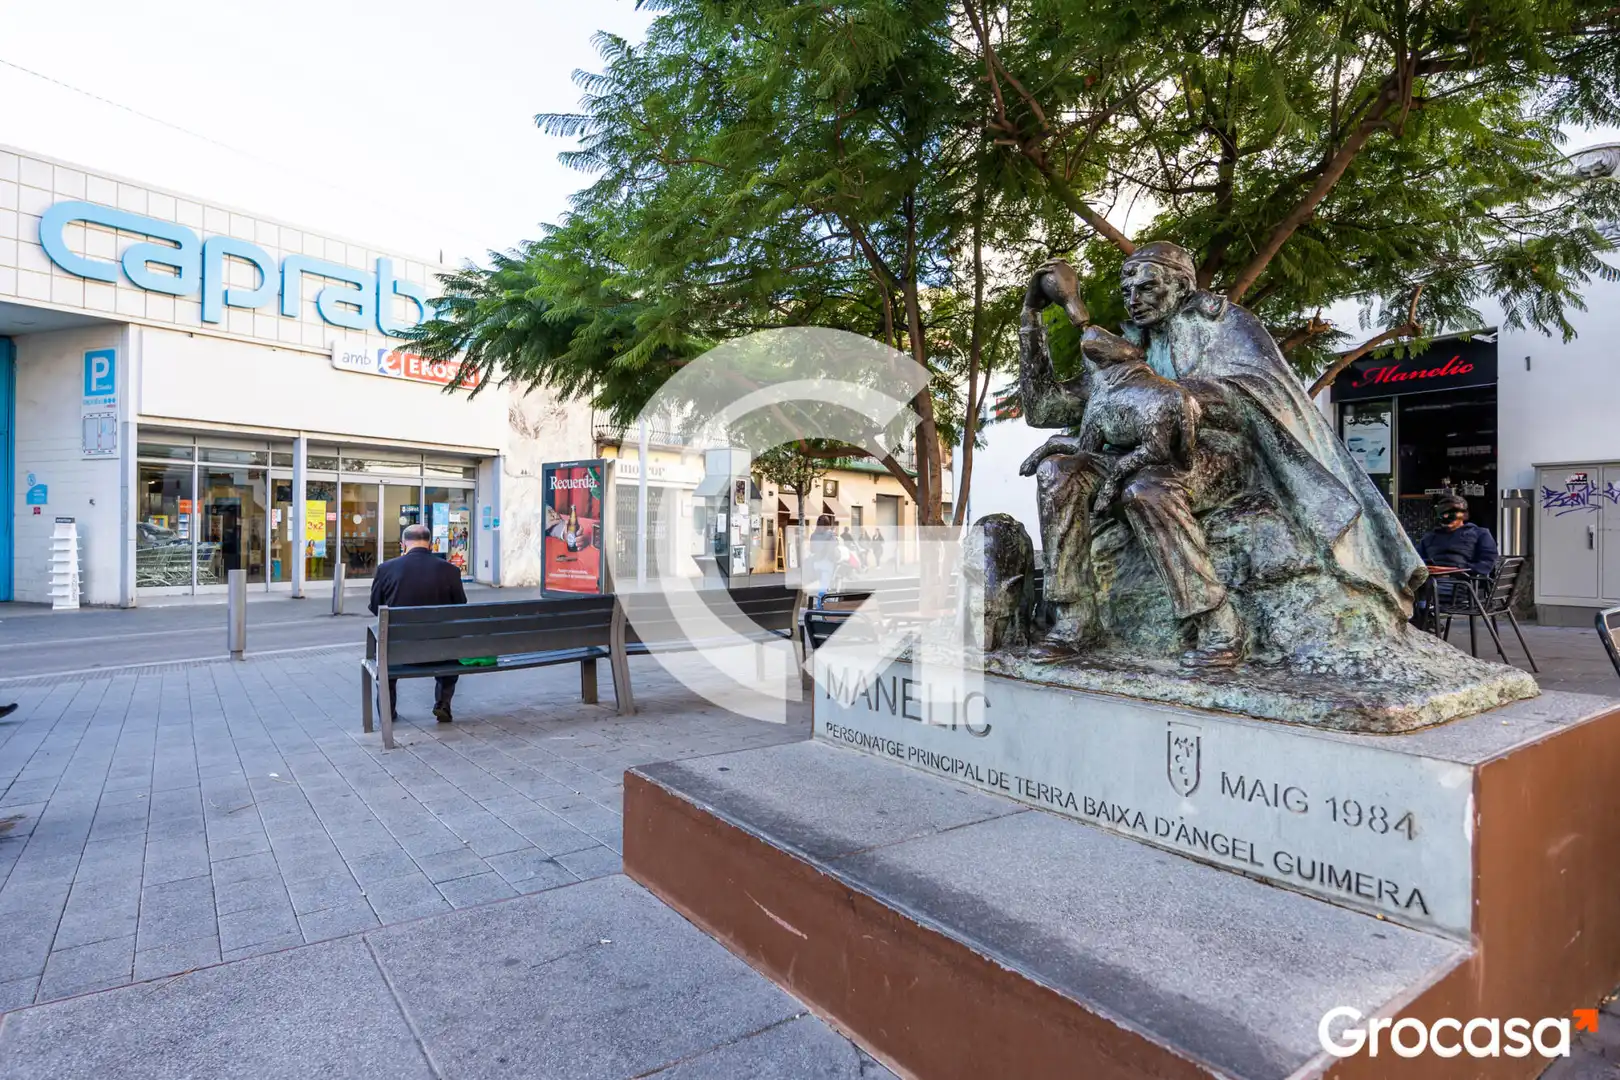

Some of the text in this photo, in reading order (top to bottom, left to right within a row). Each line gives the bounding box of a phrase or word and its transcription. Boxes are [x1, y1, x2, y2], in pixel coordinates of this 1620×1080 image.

[39, 200, 474, 346] caprab
[91, 356, 109, 391] P
[342, 351, 475, 384] amb EROS
[1352, 355, 1474, 388] Manelic
[550, 474, 597, 490] Recuerda.
[826, 664, 992, 738] MANELIC
[826, 722, 904, 758] PERSONATGE
[908, 746, 984, 783] PRINCIPAL
[988, 769, 1010, 791] DE
[1014, 776, 1078, 812] TERRA
[1084, 796, 1148, 833] BAIXA
[1273, 850, 1430, 915] GUIMERA
[1220, 771, 1415, 841] MAIG 1984
